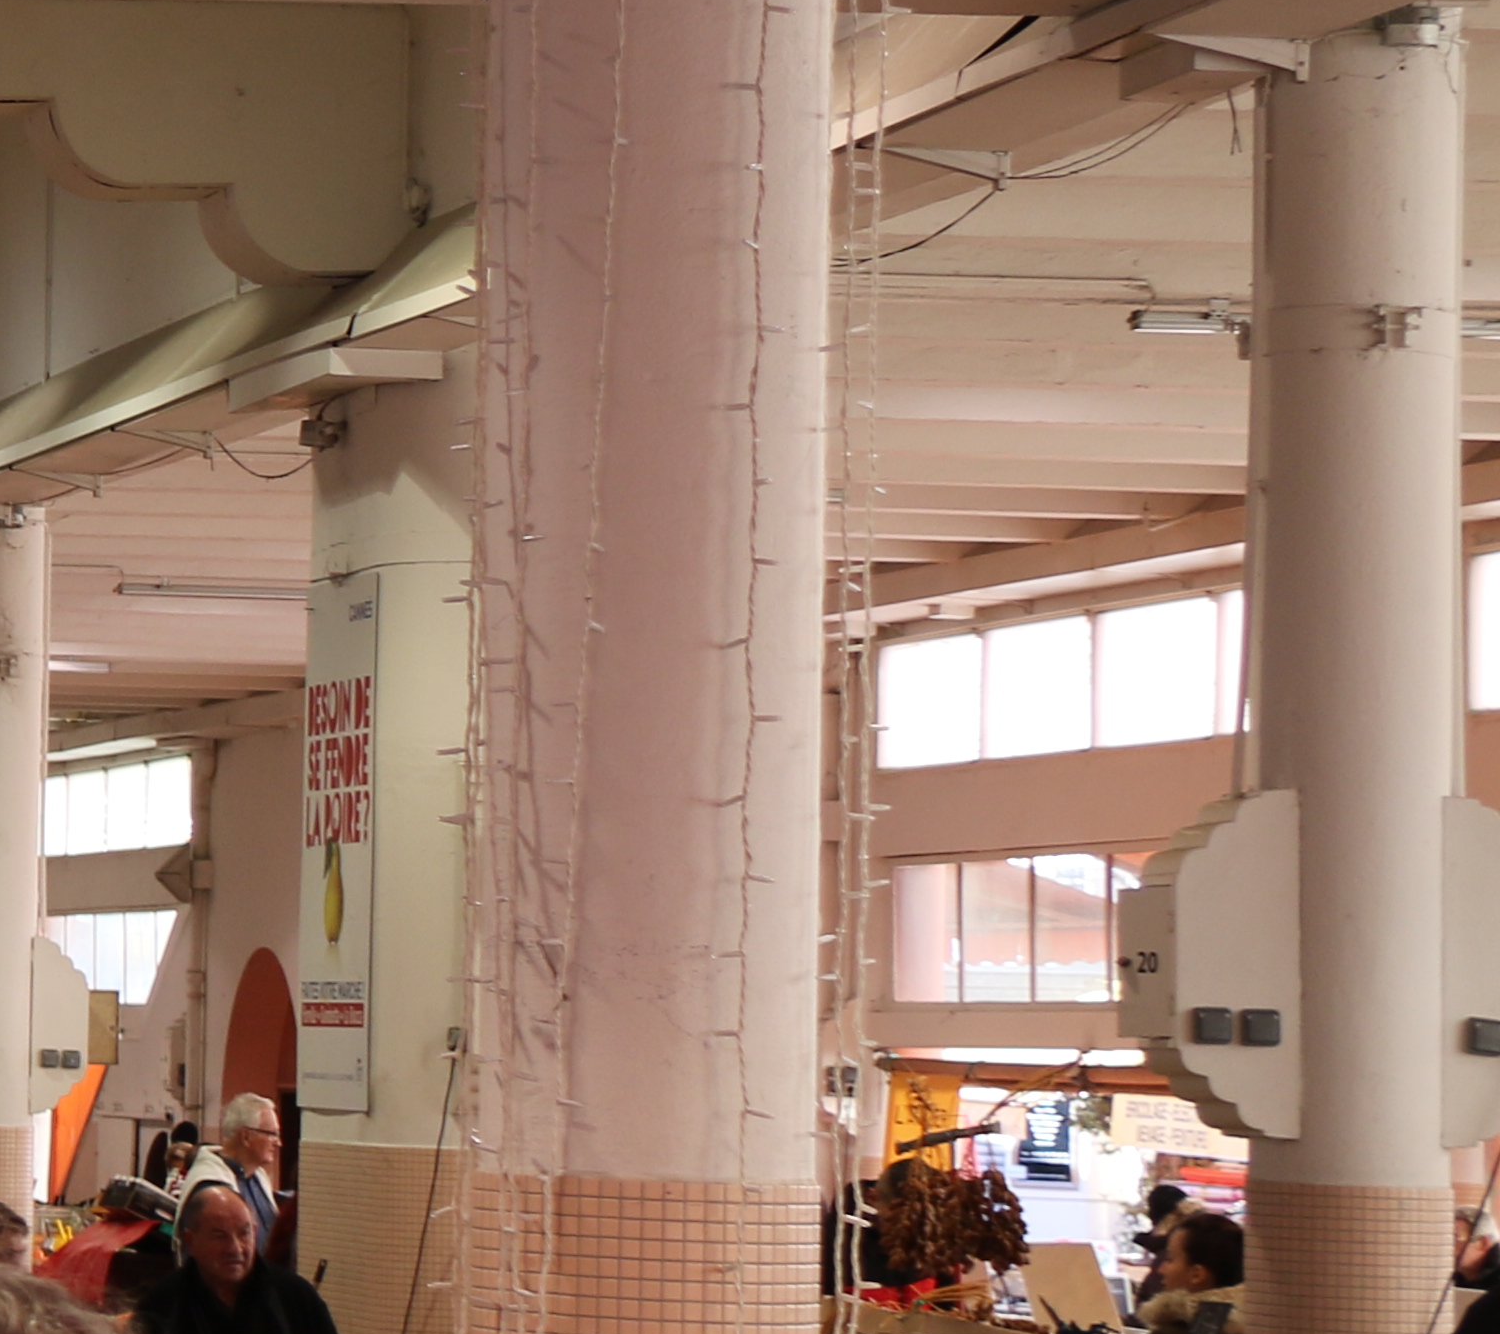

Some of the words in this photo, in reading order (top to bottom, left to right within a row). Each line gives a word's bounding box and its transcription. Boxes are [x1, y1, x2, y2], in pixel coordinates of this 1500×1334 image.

[308, 679, 350, 737] BESOIN
[354, 675, 372, 730] DE
[308, 739, 321, 792] SE
[324, 732, 369, 790] FENDRE
[306, 795, 322, 848] LA
[324, 790, 361, 844] POIRE
[1137, 951, 1158, 974] 20
